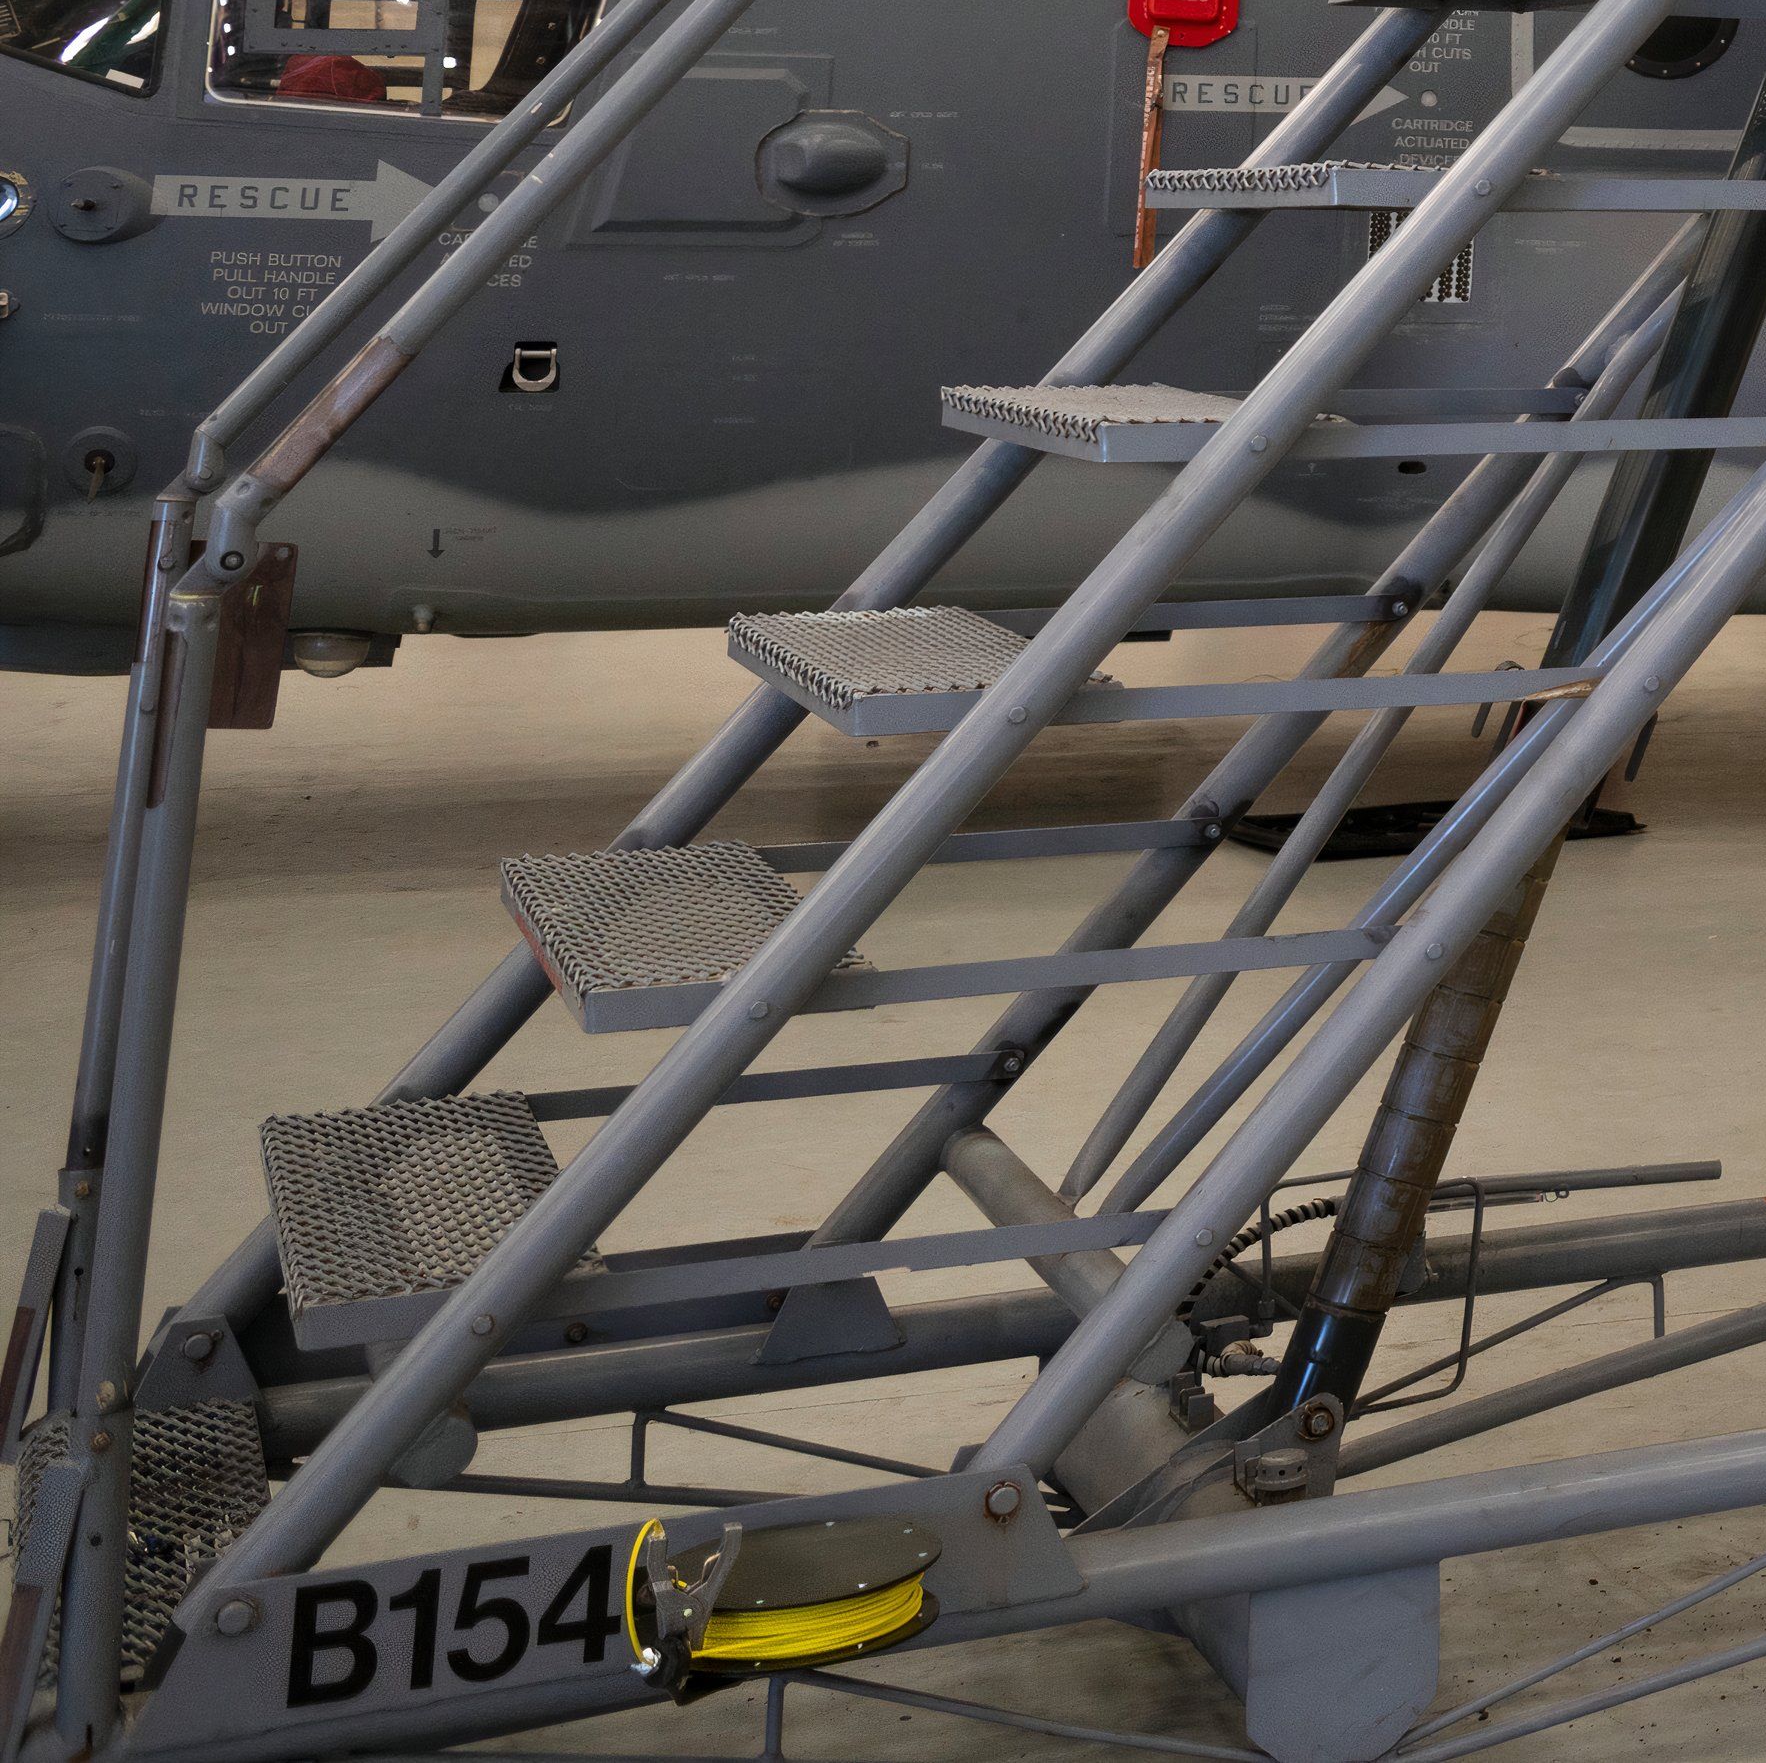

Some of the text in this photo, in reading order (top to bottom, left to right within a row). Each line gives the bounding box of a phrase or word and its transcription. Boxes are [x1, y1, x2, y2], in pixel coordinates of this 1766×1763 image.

[1445, 33, 1463, 45] FT
[1431, 47, 1472, 60] CUTS
[1409, 61, 1441, 73] OUT
[1391, 117, 1474, 133] CARTRIDGE
[1394, 135, 1470, 150] ACTUATED
[177, 183, 352, 213] RESCUE
[210, 250, 342, 268] PUSH BUTTON
[212, 269, 336, 285] PULL HANDLE
[227, 286, 318, 301] OUT 10 FT
[201, 302, 284, 317] WINDOW
[250, 320, 288, 334] OUT
[286, 1545, 622, 1708] B154
